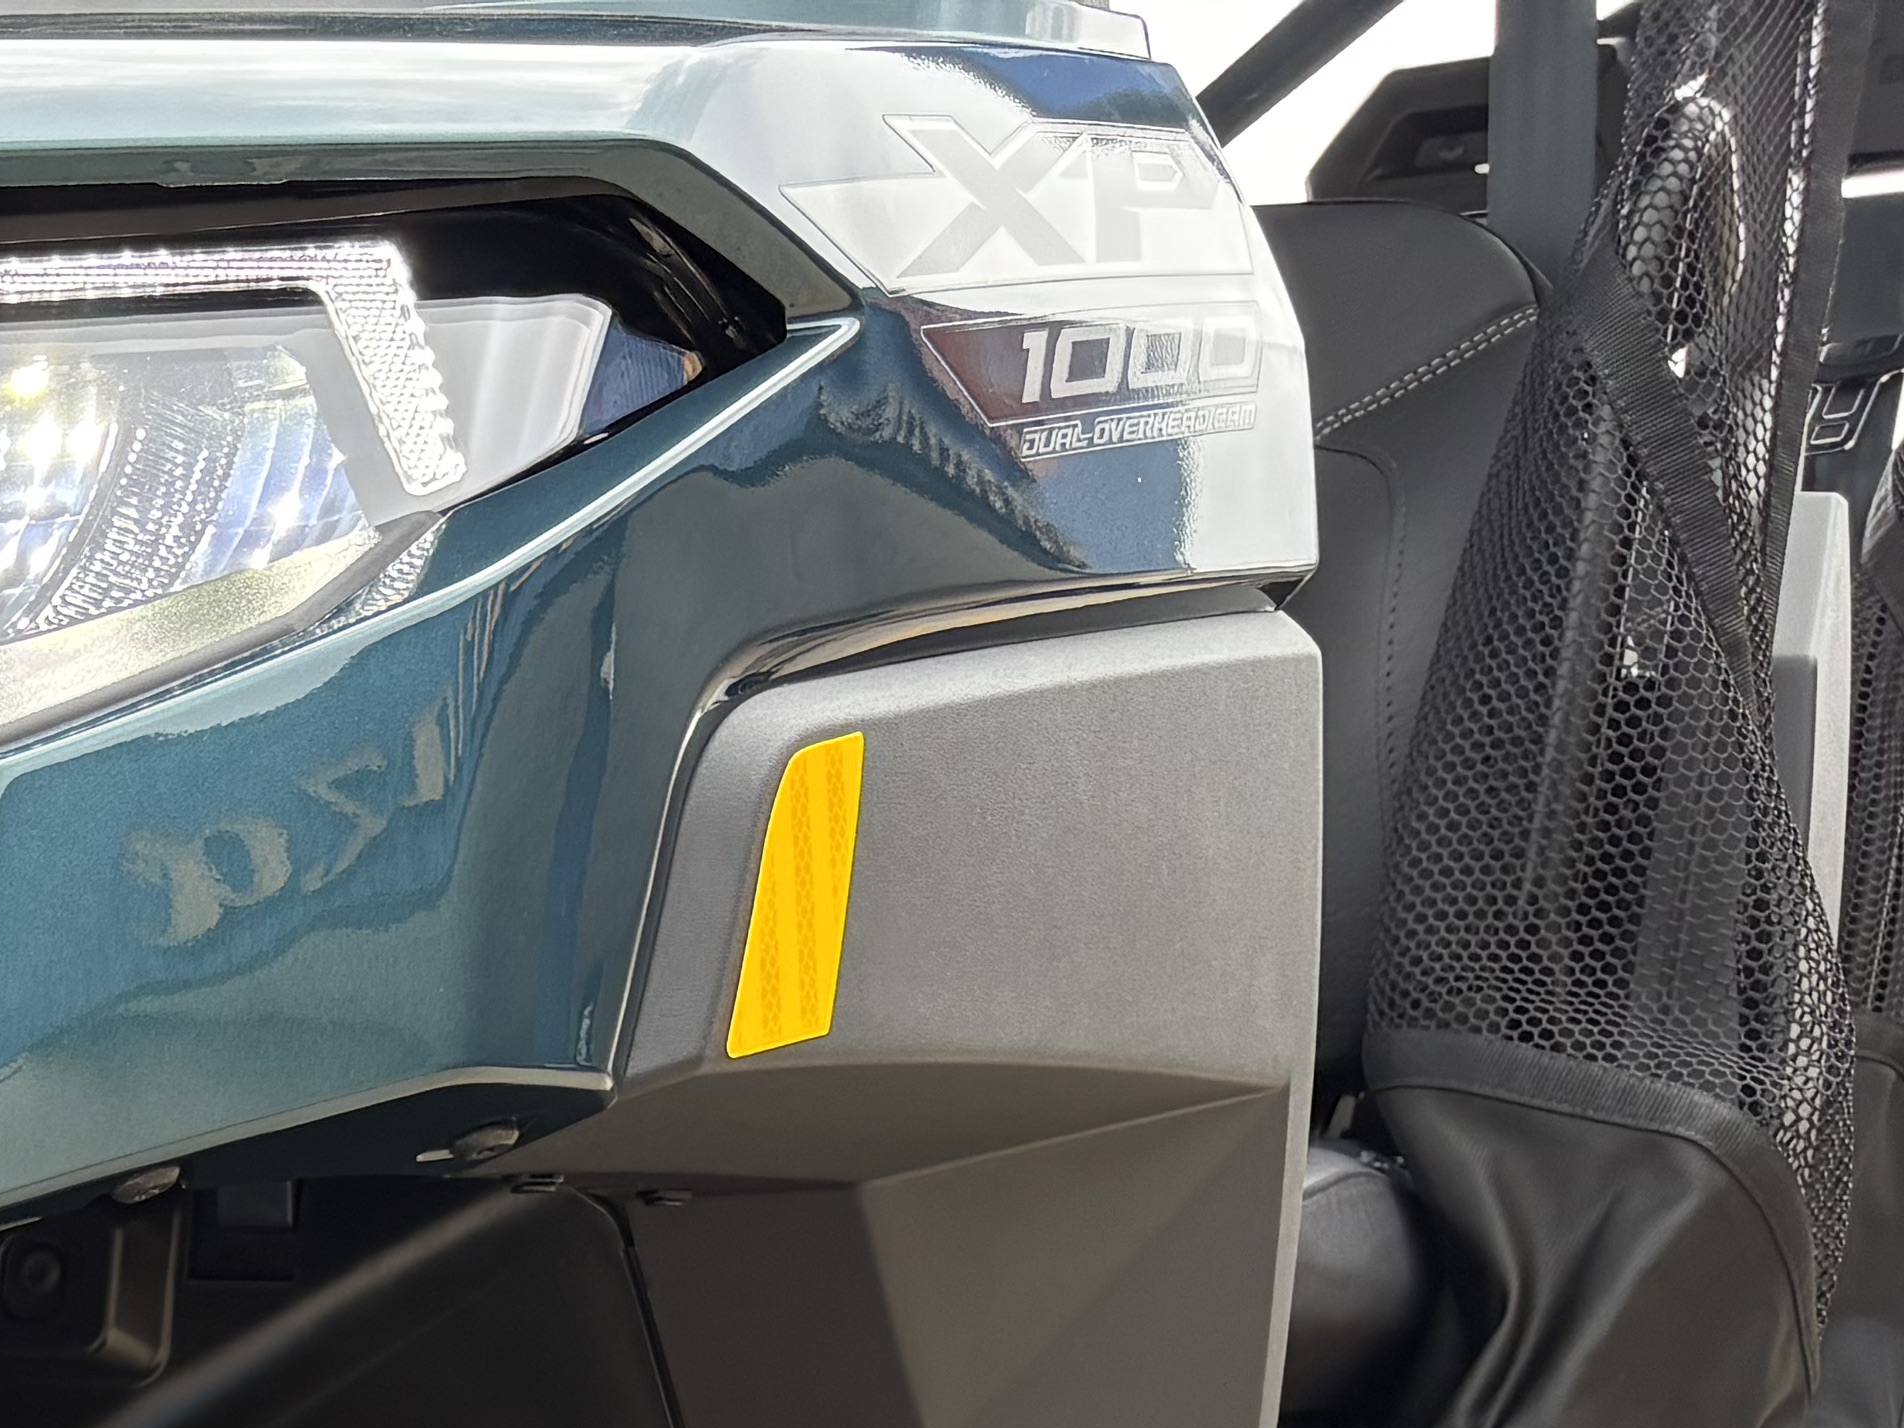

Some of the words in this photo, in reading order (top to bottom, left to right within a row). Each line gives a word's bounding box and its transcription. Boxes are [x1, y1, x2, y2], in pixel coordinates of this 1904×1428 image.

[882, 113, 1222, 280] XP
[1021, 315, 1259, 404] 1000
[1021, 421, 1088, 456] DUAL
[1093, 407, 1207, 445] OVERHEAD
[1212, 402, 1256, 429] CAM
